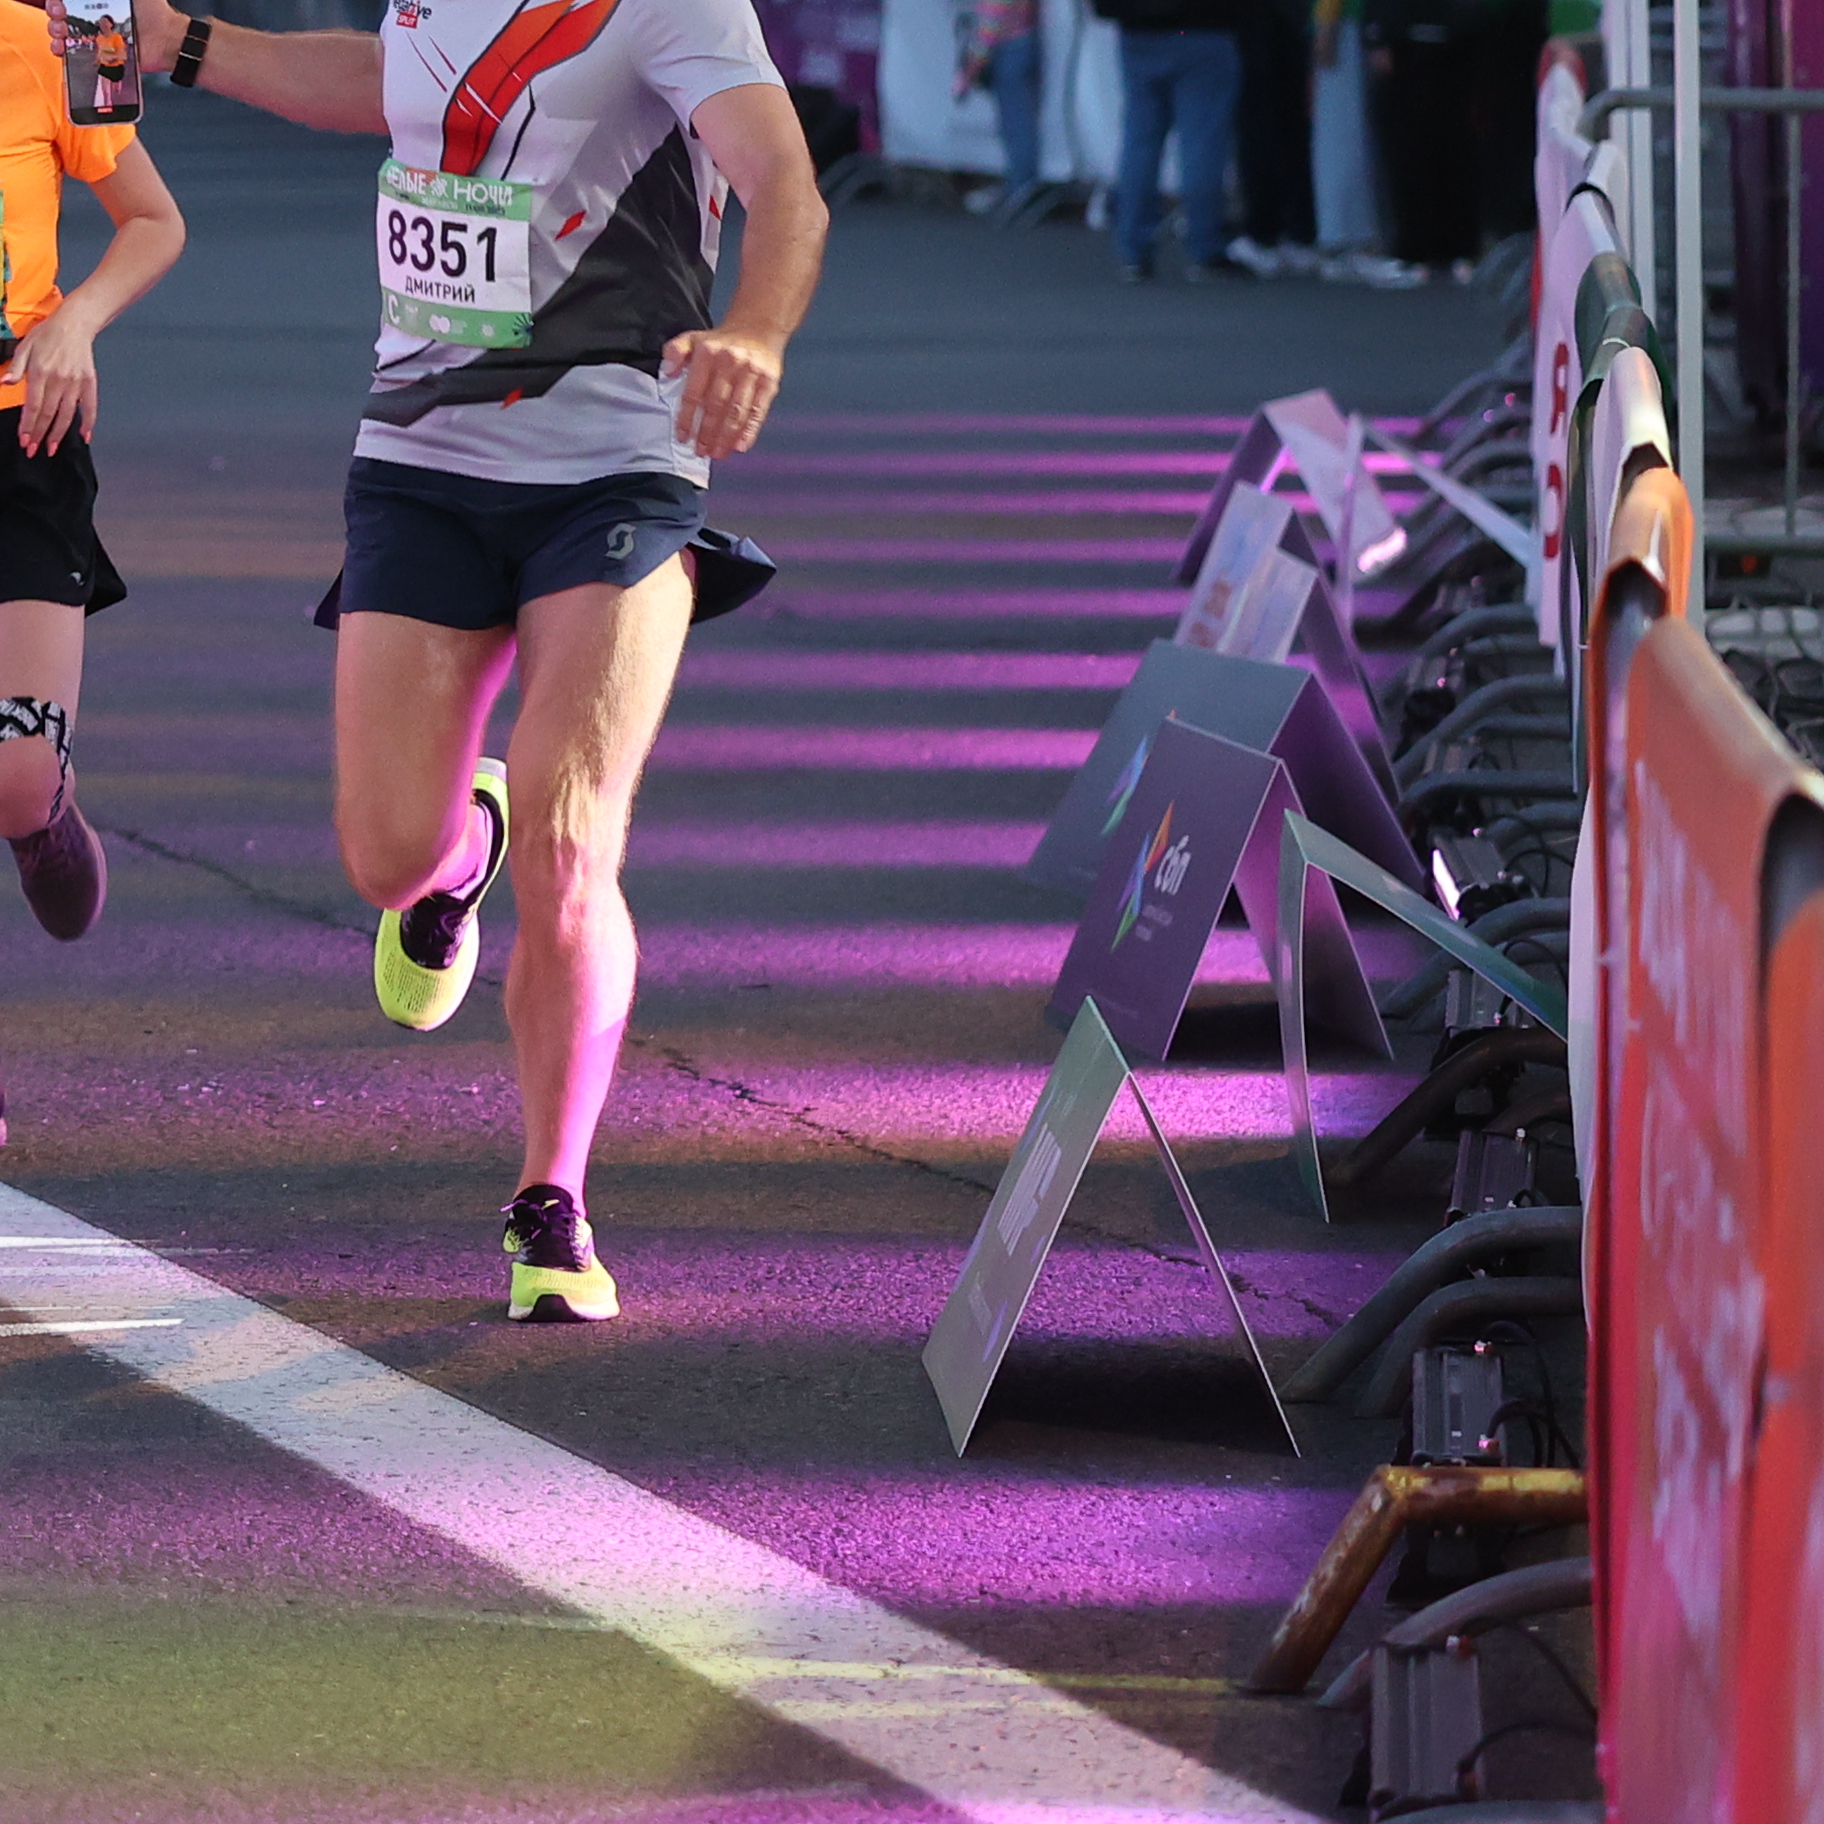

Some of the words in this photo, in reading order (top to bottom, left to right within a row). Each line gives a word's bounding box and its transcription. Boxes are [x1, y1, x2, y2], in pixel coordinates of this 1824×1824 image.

[453, 178, 513, 206] НОЧИ
[388, 209, 498, 283] 8351
[405, 275, 476, 304] ДМИТРИЙ
